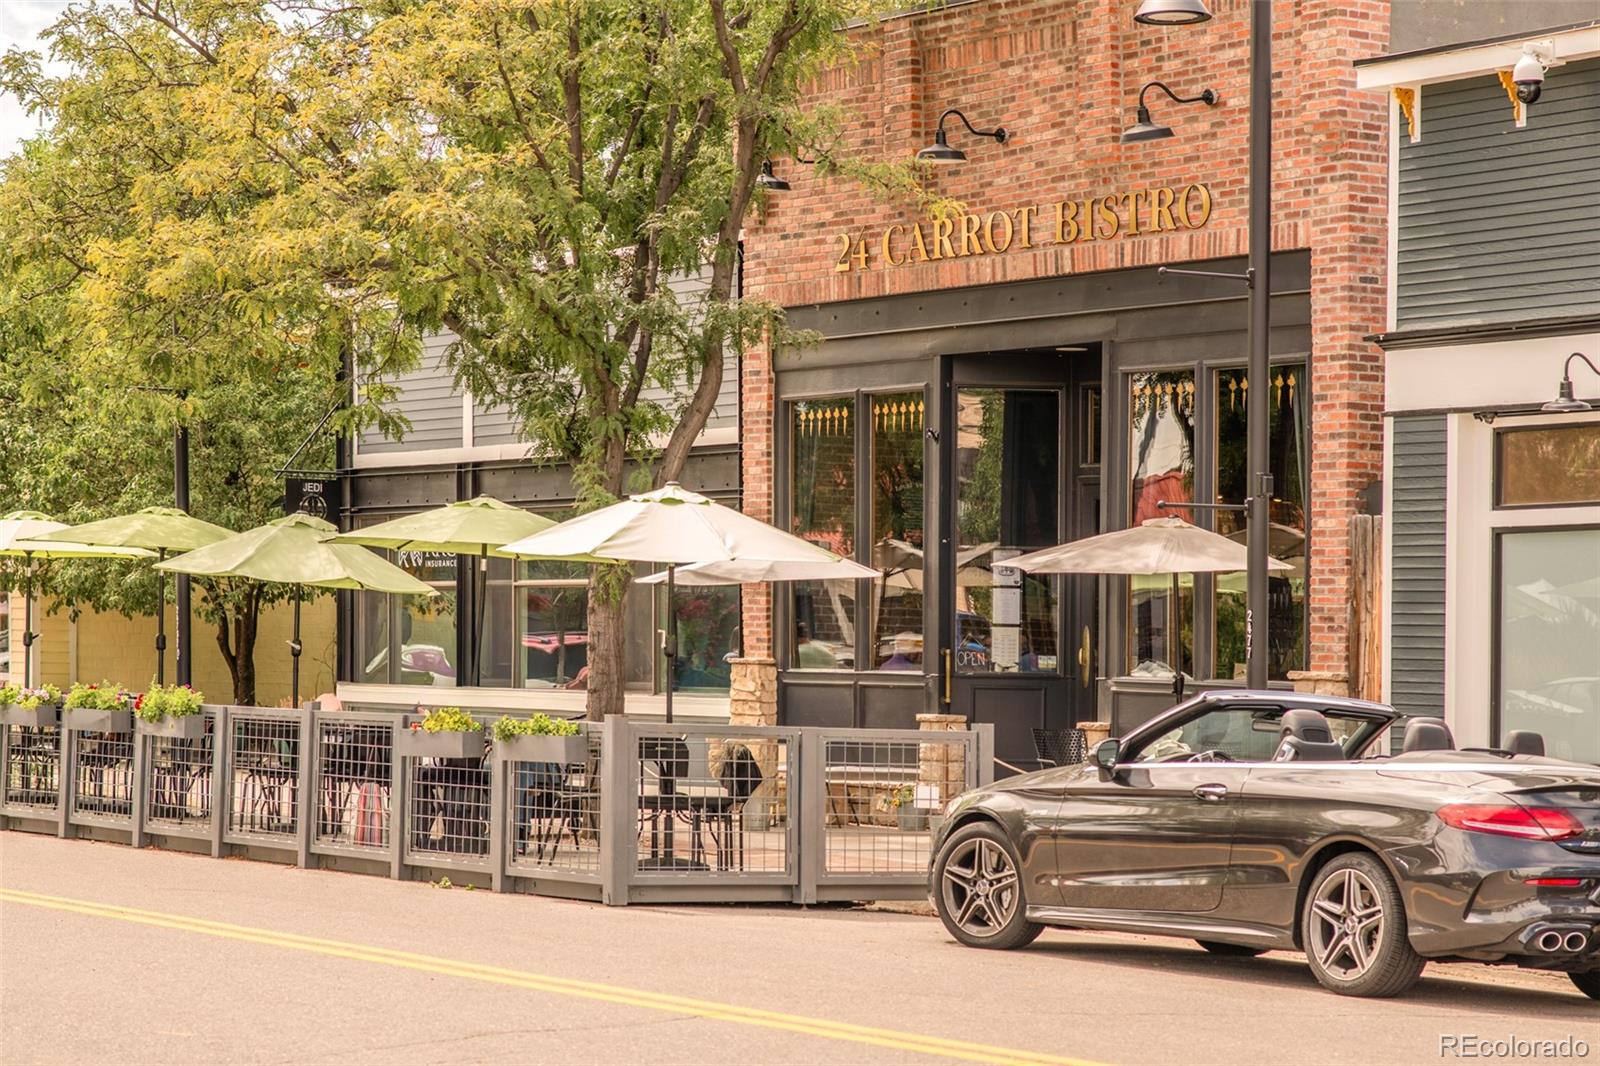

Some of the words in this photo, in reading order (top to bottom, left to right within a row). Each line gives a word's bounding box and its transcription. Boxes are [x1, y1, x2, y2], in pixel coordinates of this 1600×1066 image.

[835, 225, 869, 272] 24
[881, 204, 1038, 266] CARROT
[1054, 183, 1212, 245] BISTRO
[302, 482, 323, 493] JEDI
[957, 651, 986, 666] OPEN
